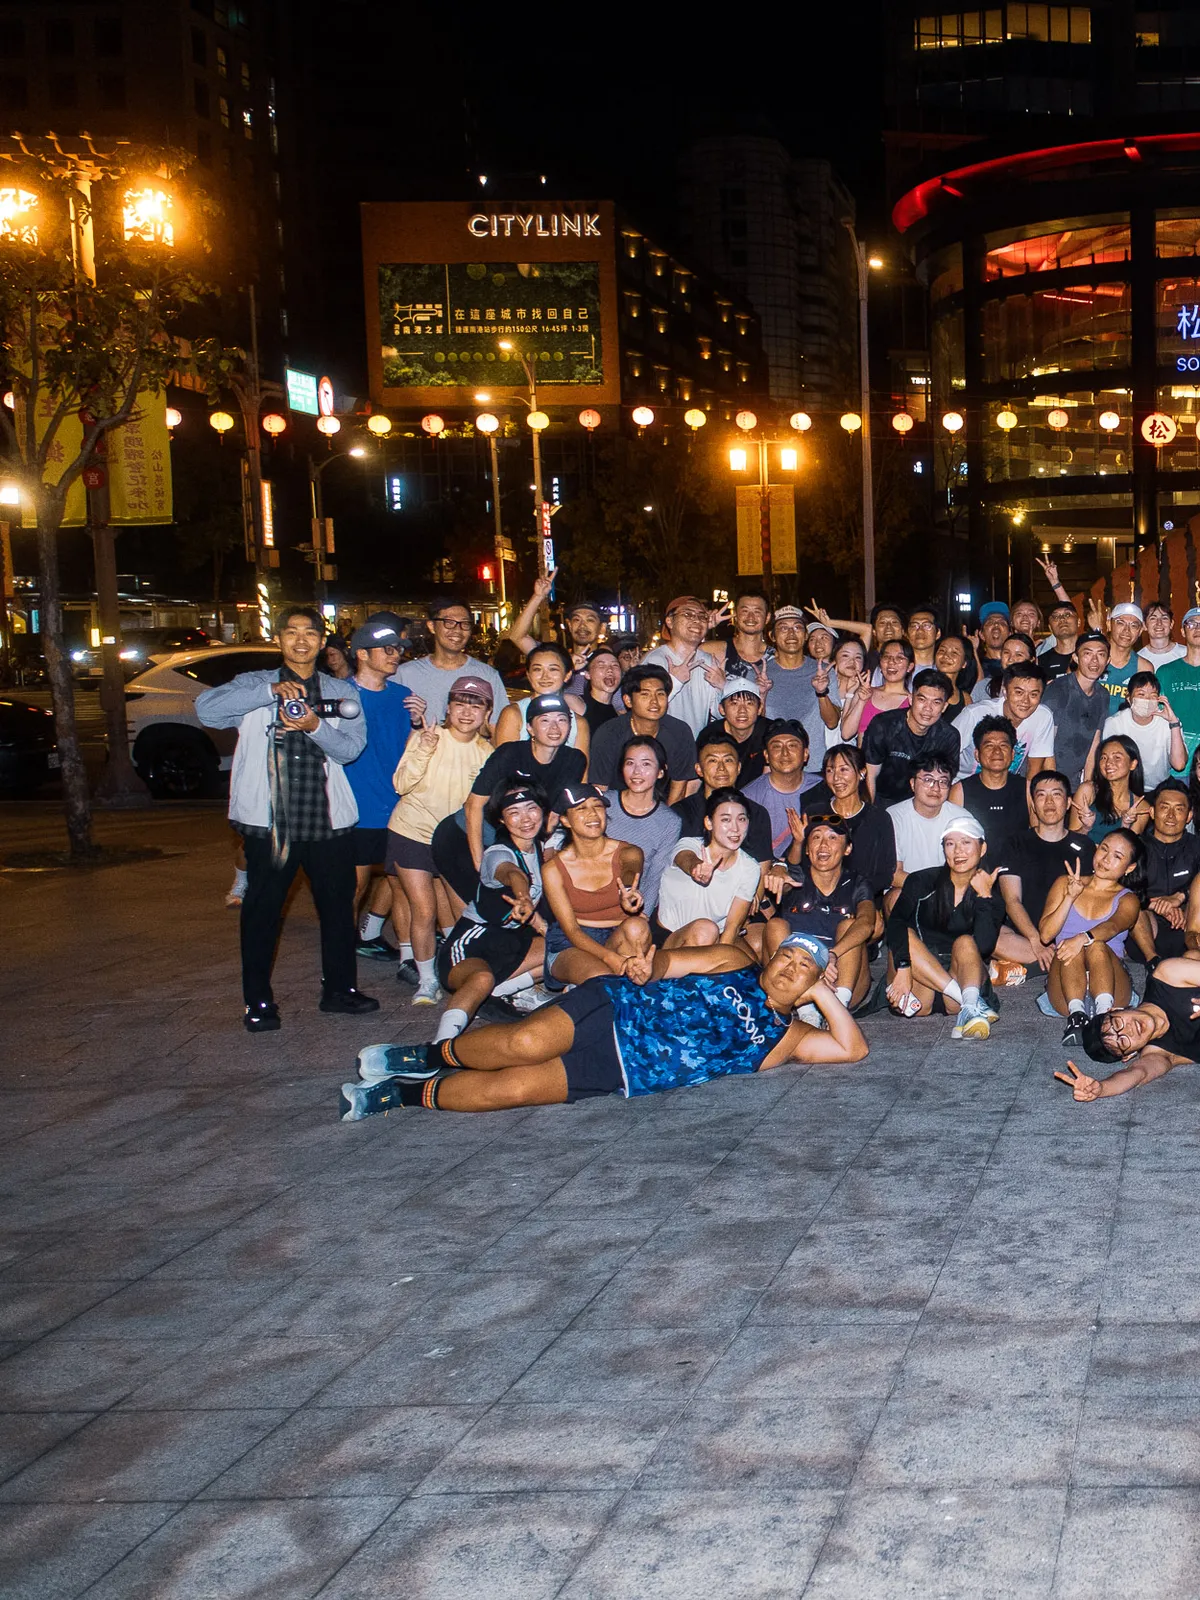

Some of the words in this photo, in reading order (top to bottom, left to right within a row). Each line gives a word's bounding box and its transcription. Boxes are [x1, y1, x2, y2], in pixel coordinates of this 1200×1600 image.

[468, 214, 601, 237] CITYLINK
[454, 307, 589, 321] 在這座城市找回自己
